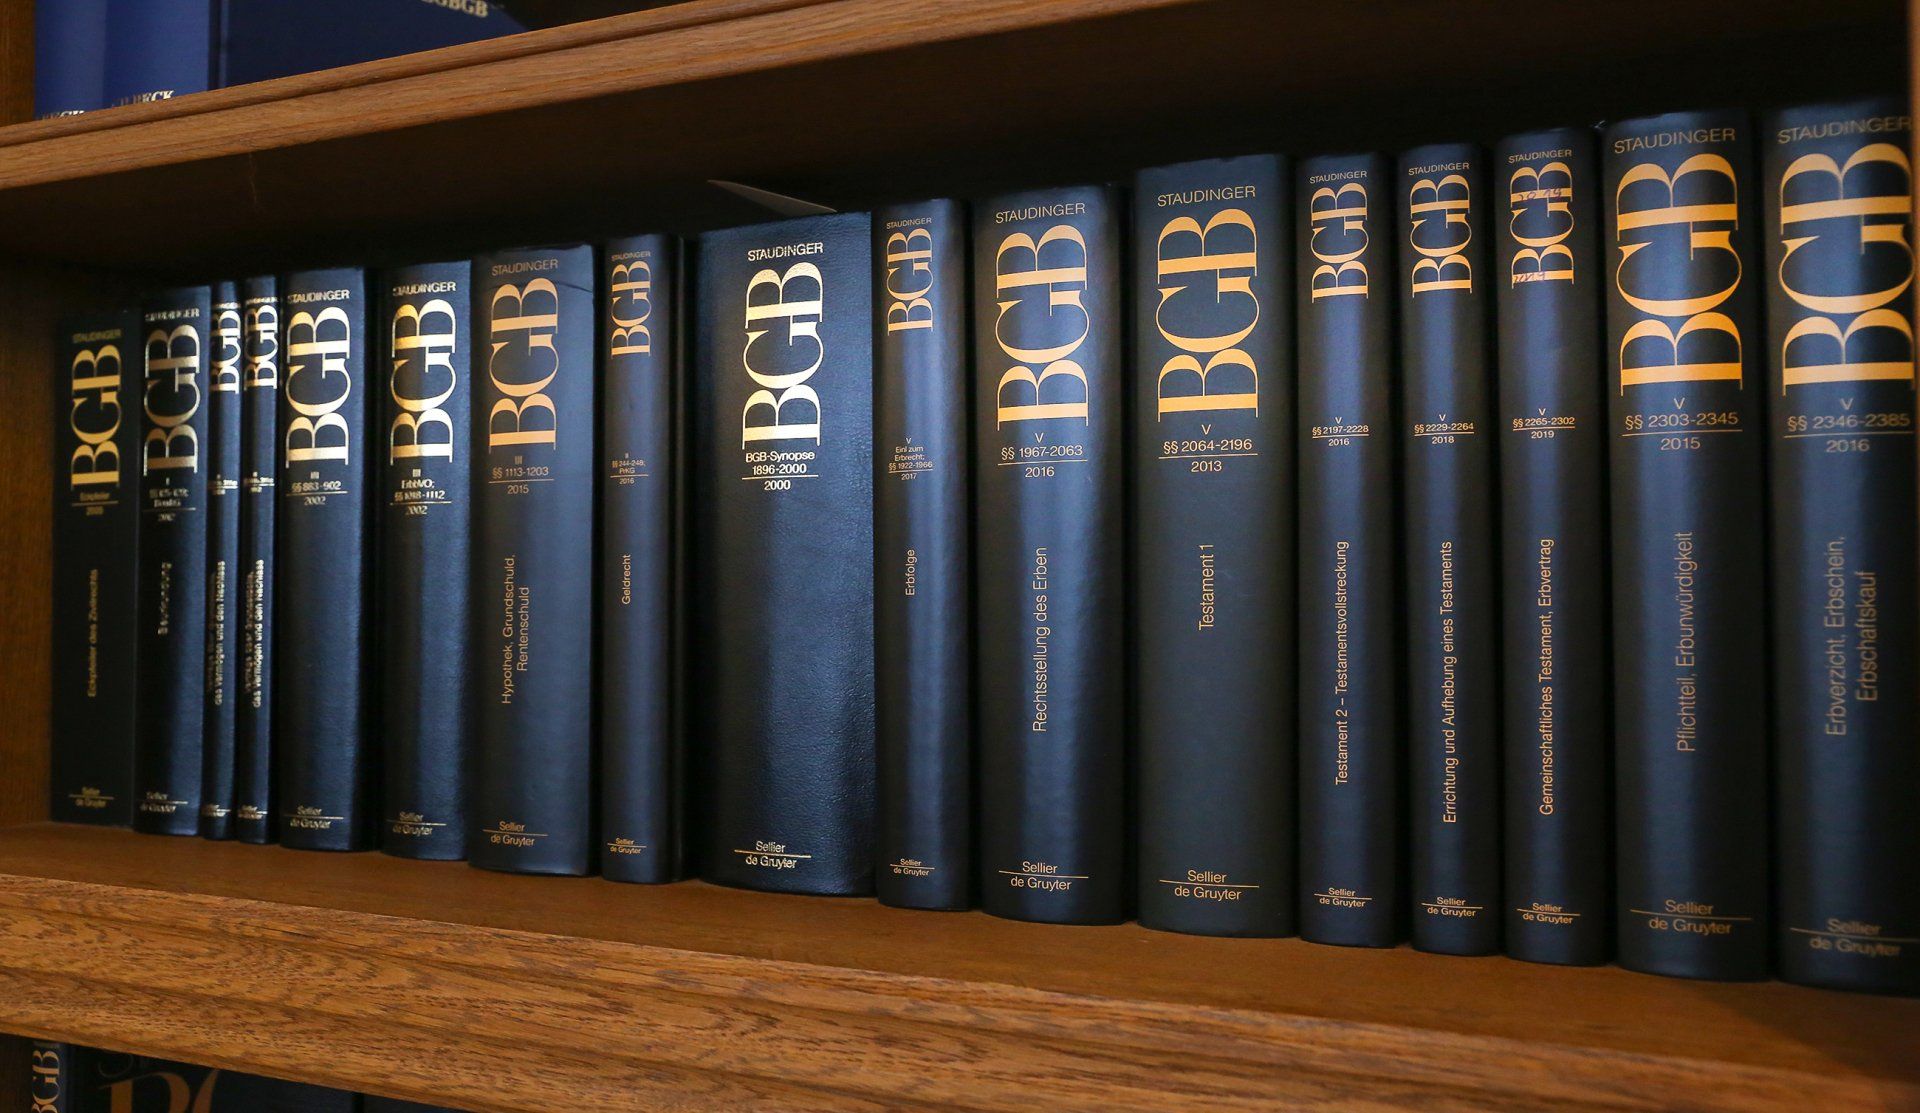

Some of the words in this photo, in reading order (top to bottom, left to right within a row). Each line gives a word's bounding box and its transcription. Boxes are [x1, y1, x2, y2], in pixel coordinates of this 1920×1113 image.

[1777, 116, 1912, 144] STAUDINGER
[1614, 128, 1736, 154] STAUDINGER
[1508, 149, 1572, 164] STAUDINGER
[1309, 170, 1367, 184] STAUDINGER
[1408, 162, 1470, 176] STAUDINGER
[1157, 185, 1256, 207] STAUDINGER
[995, 203, 1086, 224] STAUDINGER
[886, 217, 932, 230] STAUDINGER
[1510, 161, 1574, 290] BGB
[1311, 183, 1369, 303] BGB
[1410, 174, 1472, 298] BGB
[611, 251, 651, 261] STAUDINGER
[747, 242, 823, 261] STAUDINGER
[492, 258, 558, 276] STAUDINGER
[1617, 153, 1742, 396] BGB
[1779, 143, 1915, 396] BGB
[886, 228, 934, 336] BGB
[611, 260, 651, 359] BGB
[1156, 208, 1260, 422] BGB
[995, 224, 1090, 431] BGB
[209, 309, 241, 394] BGB
[243, 304, 278, 389] BGB
[742, 261, 824, 450] BGB
[489, 277, 559, 454] BGB
[285, 306, 351, 468] BGB
[390, 299, 457, 466] BGB
[143, 324, 200, 476] BGB
[1674, 398, 1685, 410] V
[1840, 398, 1853, 410] V
[71, 344, 121, 490] BGB
[1335, 416, 1342, 424] V
[1439, 413, 1446, 422] V
[1538, 408, 1546, 416] V
[1201, 424, 1211, 435] V
[1414, 425, 1424, 434] §§
[1425, 423, 1474, 433] 2229-2264
[1512, 418, 1523, 428] §§
[1524, 417, 1575, 427] 2265-2302
[1625, 416, 1643, 430] §§
[1648, 413, 1738, 428] 2303-2345
[1788, 416, 1807, 431] §§
[1813, 413, 1910, 429] 2346-2385
[1034, 432, 1044, 443] V
[1312, 427, 1321, 436] §§
[1323, 425, 1369, 434] 2197-2228
[1531, 430, 1554, 439] 2019
[1163, 440, 1178, 454] §§
[1182, 438, 1253, 452] 2064-2196
[1328, 438, 1350, 446] 2016
[1431, 436, 1455, 445] 2018
[1661, 438, 1700, 450] 2015
[1826, 438, 1870, 453] 2016
[515, 455, 523, 464] III
[745, 450, 815, 463] BGB-Synopse
[1001, 446, 1015, 460] §§
[1019, 445, 1083, 458] 1967-2063
[492, 467, 503, 479] §§
[505, 466, 549, 477] 1113-1203
[752, 463, 807, 475] 1896-2000
[888, 463, 897, 471] §§
[898, 461, 933, 470] 1922-1966
[1025, 467, 1055, 478] 2016
[1191, 460, 1222, 472] 2013
[302, 481, 341, 491] 883-902
[507, 484, 529, 495] 2015
[619, 477, 635, 485] 2016
[764, 480, 790, 490] 2000
[905, 549, 918, 596] Erbfolge
[1033, 547, 1047, 590] Erben
[1538, 539, 1554, 607] Erbvertrag
[622, 554, 631, 605] Geldrecht
[1440, 541, 1452, 615] Testaments
[1823, 536, 1846, 628] Erbschein,
[503, 555, 516, 637] Grundschuld,
[1199, 553, 1214, 631] Testament
[1674, 531, 1697, 667] Erbunwürdigkeit
[255, 604, 263, 621] den
[1033, 594, 1047, 622] des
[1335, 541, 1349, 695] Testamentsvollstreckung
[517, 587, 530, 672] Rentenschuld
[1441, 619, 1453, 651] eines
[1855, 570, 1878, 701] Erbschaftskauf
[1539, 612, 1554, 682] Testament,
[502, 643, 513, 703] Hypothek,
[1032, 626, 1050, 732] Rechtsstellung
[1442, 656, 1457, 726] Aufhebung
[1825, 635, 1847, 736] Erbverzicht,
[1336, 708, 1348, 717] 2
[1677, 673, 1697, 751] Pflichtteil,
[1442, 730, 1456, 754] und
[1335, 720, 1348, 785] Testament
[1539, 687, 1553, 815] Gemeinschaftliches
[1443, 757, 1459, 824] Errichtung
[499, 821, 526, 832] Sellier
[490, 834, 501, 844] de
[503, 834, 535, 846] Gruyter
[615, 838, 634, 846] Sellier
[756, 841, 785, 853] Sellier
[745, 855, 758, 866] de
[760, 855, 797, 869] Gruyter
[900, 859, 921, 867] Sellier
[1022, 860, 1057, 874] Sellier
[904, 868, 930, 877] Gruyter
[1187, 869, 1227, 883] Sellier
[1010, 876, 1025, 887] de
[1027, 877, 1072, 892] Gruyter
[1328, 887, 1356, 897] Sellier
[1174, 886, 1190, 897] de
[1193, 887, 1242, 901] Gruyter
[1436, 896, 1466, 906] Sellier
[1319, 898, 1330, 906] de
[1333, 898, 1365, 908] Gruyter
[1532, 903, 1562, 912] Sellier
[1665, 900, 1714, 915] Sellier
[1427, 907, 1438, 915] de
[1440, 907, 1476, 917] Gruyter
[1522, 913, 1534, 921] de
[1537, 914, 1573, 924] Gruyter
[1649, 917, 1668, 929] de
[1673, 918, 1732, 936] Gruyter
[1827, 918, 1881, 935] Sellier
[1809, 937, 1830, 950] de
[1835, 938, 1900, 957] Gruyter
